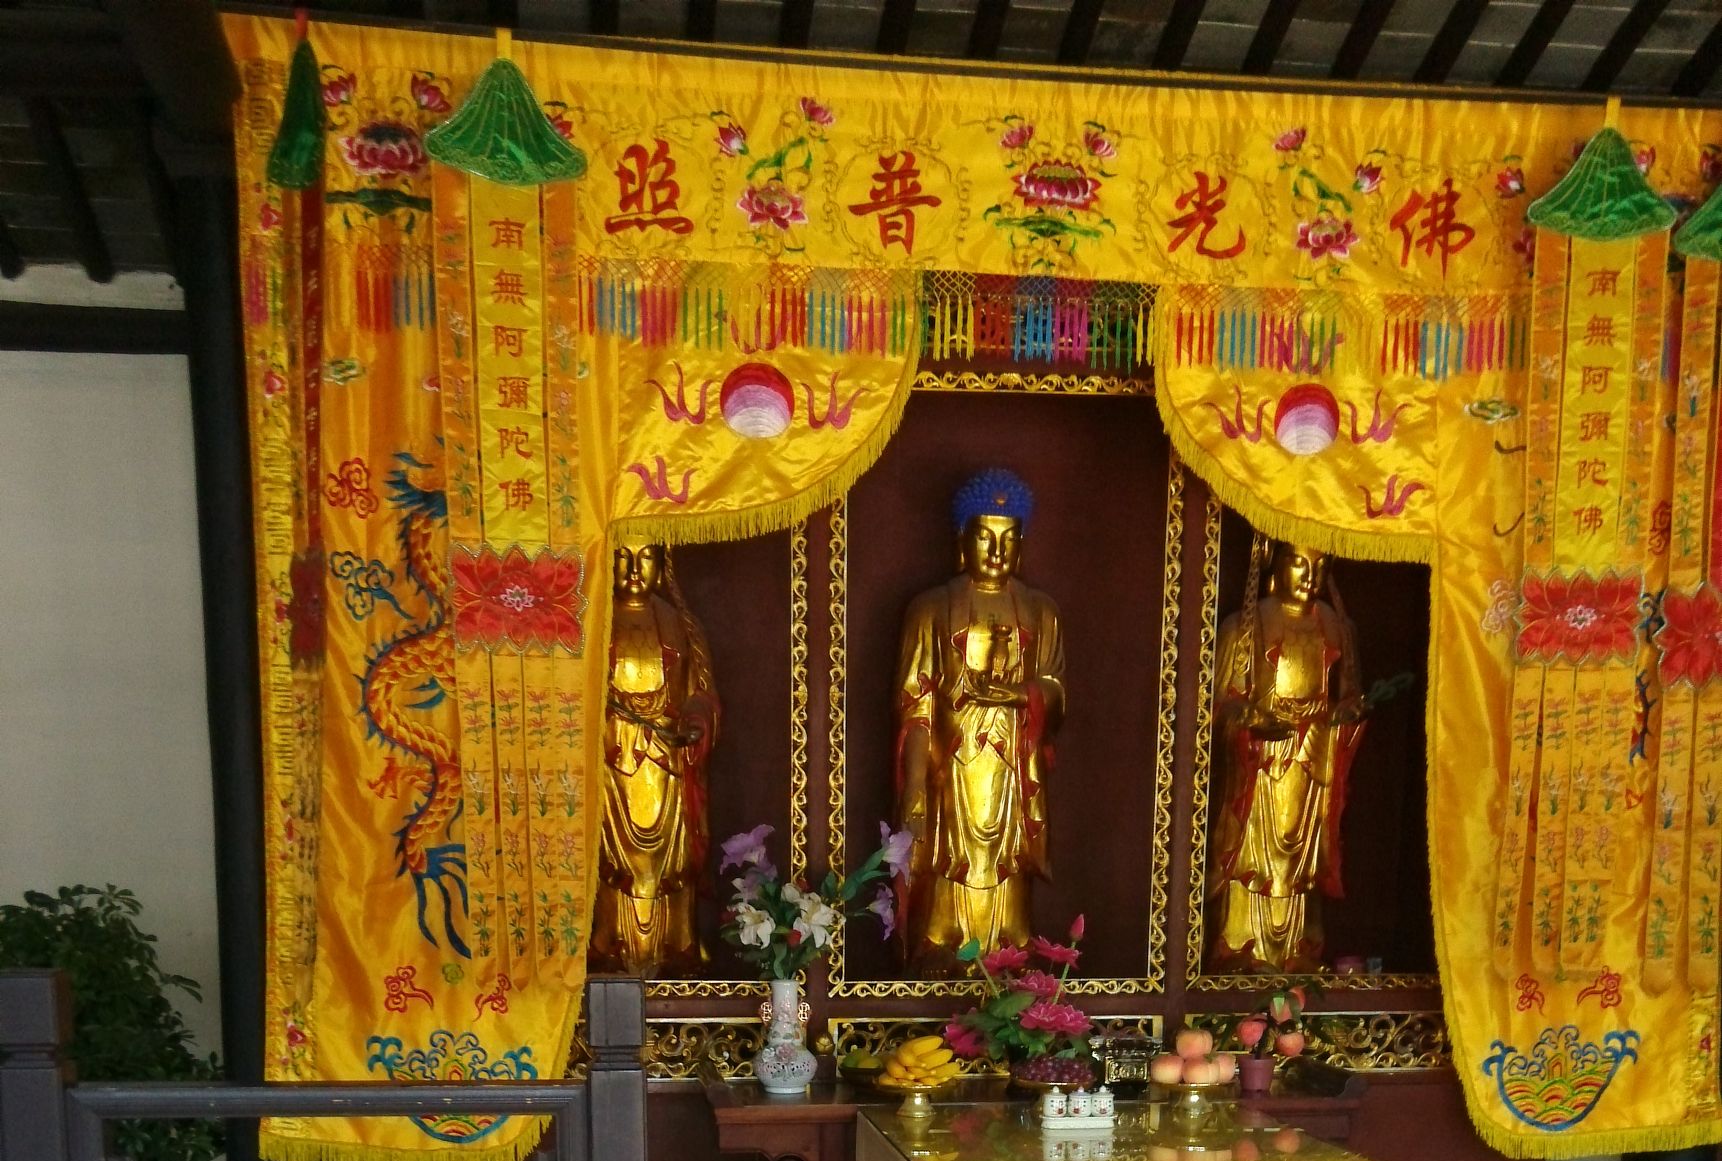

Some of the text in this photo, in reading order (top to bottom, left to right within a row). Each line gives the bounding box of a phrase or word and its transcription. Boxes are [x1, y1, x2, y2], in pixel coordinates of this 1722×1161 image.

[488, 217, 534, 511] 南無阿彌陀佛
[1572, 266, 1621, 537] 南無阿彌陀佛
